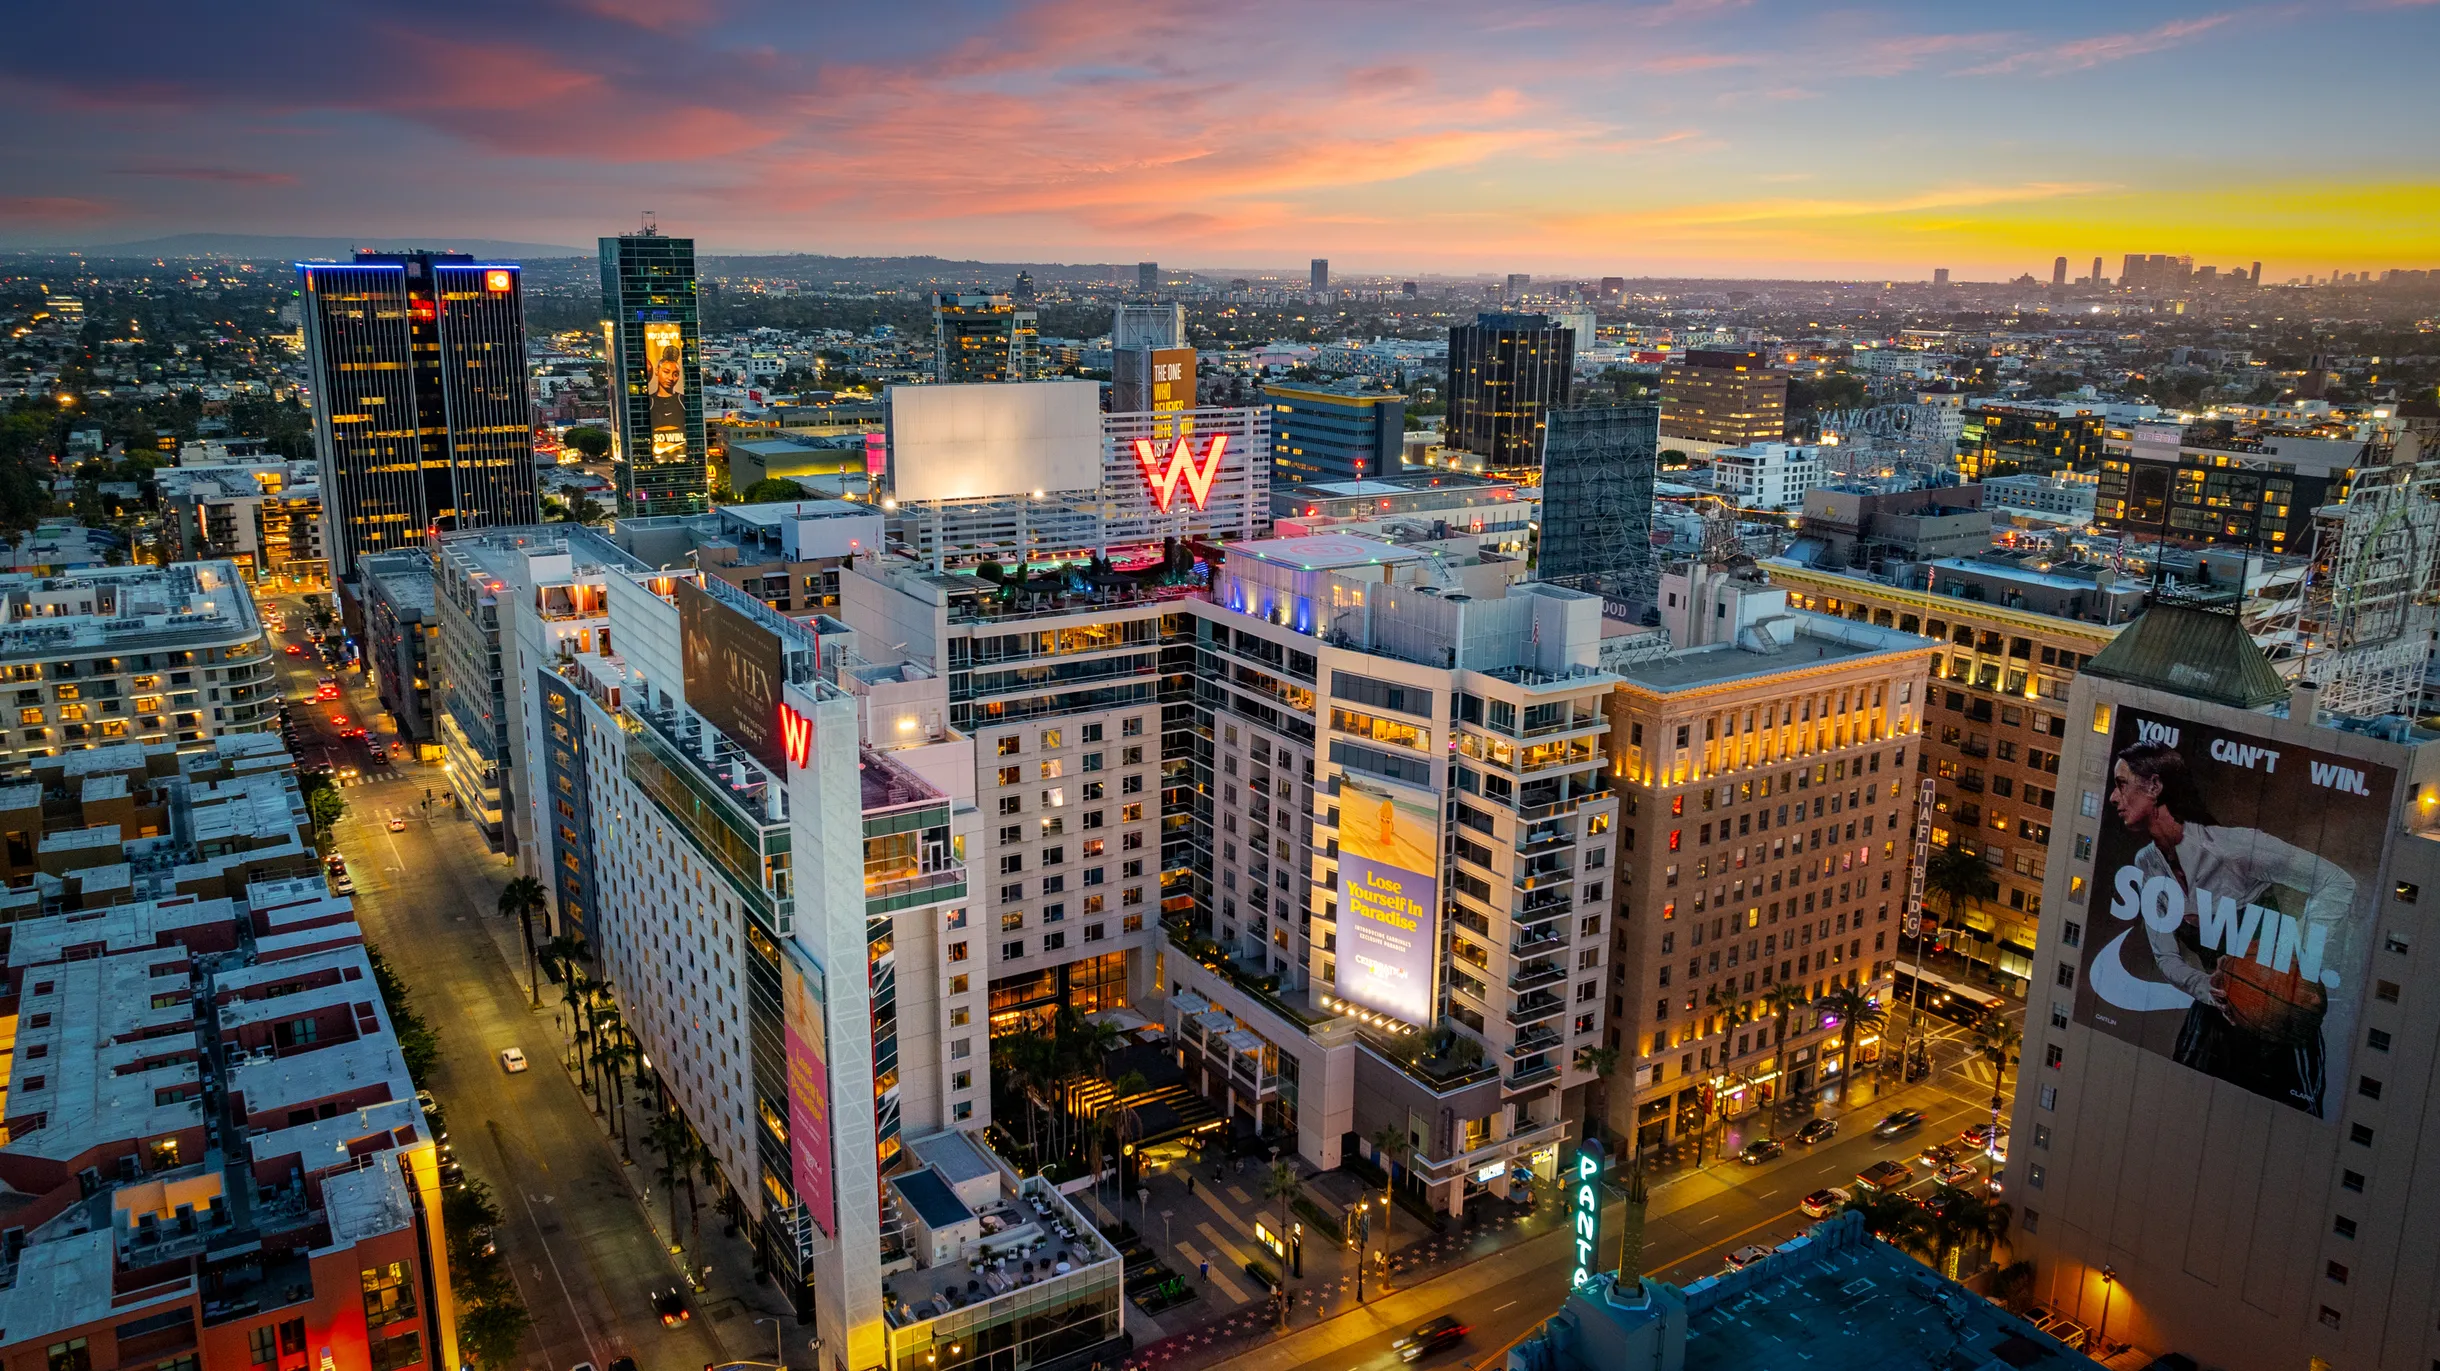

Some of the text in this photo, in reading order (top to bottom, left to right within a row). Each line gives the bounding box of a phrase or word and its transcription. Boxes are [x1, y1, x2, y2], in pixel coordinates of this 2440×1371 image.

[1154, 363, 1182, 382] THE ONE
[1154, 382, 1171, 401] WHO
[653, 432, 686, 443] SO WIN.
[1133, 433, 1230, 515] W
[738, 720, 758, 743] MARCH
[779, 703, 812, 770] W
[2136, 718, 2370, 797] YOU CAN'T WIN.
[1917, 789, 1933, 856] TAFT
[1366, 870, 1402, 895] Lose
[1345, 879, 1423, 918] Yourself In
[1908, 865, 1924, 930] BLDG
[1350, 898, 1417, 933] Paradise
[2109, 865, 2341, 990] SO WIN.
[1354, 924, 1385, 940] INTRODUCING
[1359, 932, 1406, 953] EXCLUSIVE PARADISE
[796, 1047, 813, 1078] Lose
[1159, 1275, 1185, 1299] W
[811, 1340, 820, 1351] M
